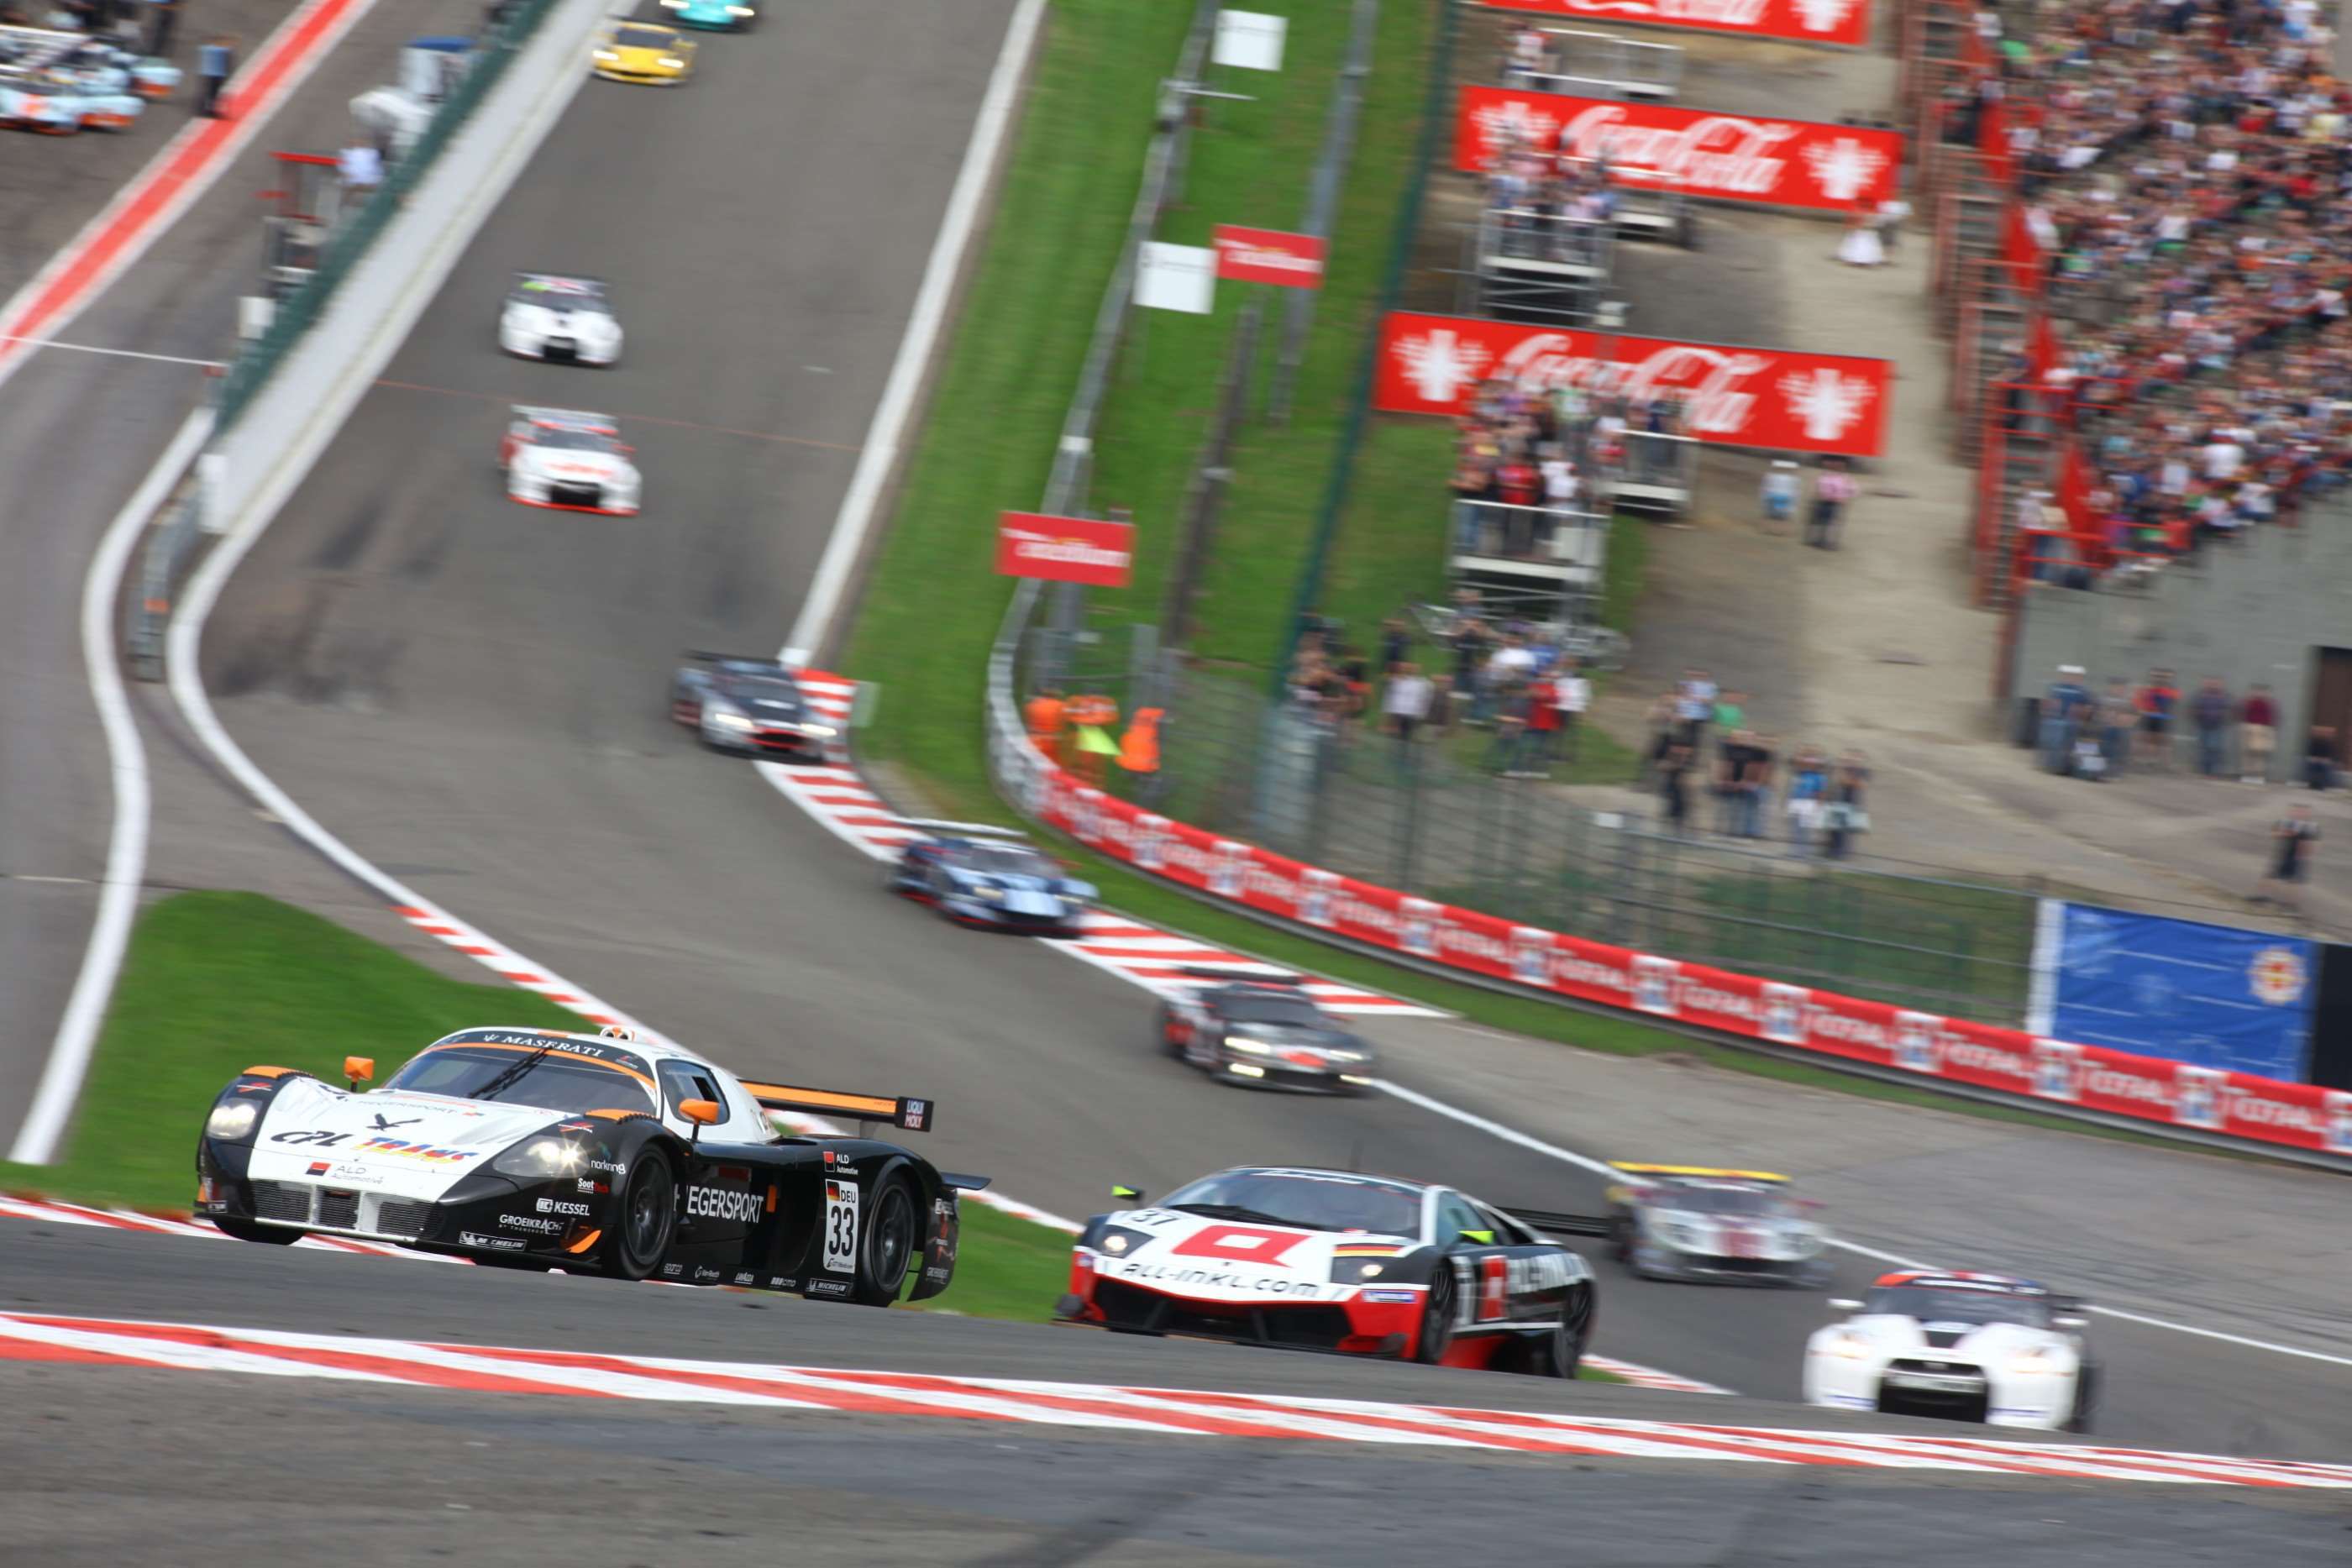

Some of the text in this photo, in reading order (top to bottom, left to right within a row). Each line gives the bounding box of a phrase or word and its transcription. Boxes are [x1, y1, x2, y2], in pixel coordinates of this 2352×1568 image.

[501, 1036, 605, 1057] MASERATI
[906, 1099, 925, 1114] LIQUI
[905, 1114, 923, 1129] MOLY
[837, 1153, 850, 1164] ALD
[841, 1189, 856, 1203] DEU
[554, 1201, 591, 1216] KESSEL
[828, 1205, 854, 1257] 33
[476, 1237, 525, 1248] MCHELIN
[817, 1282, 847, 1292] MICHELIN
